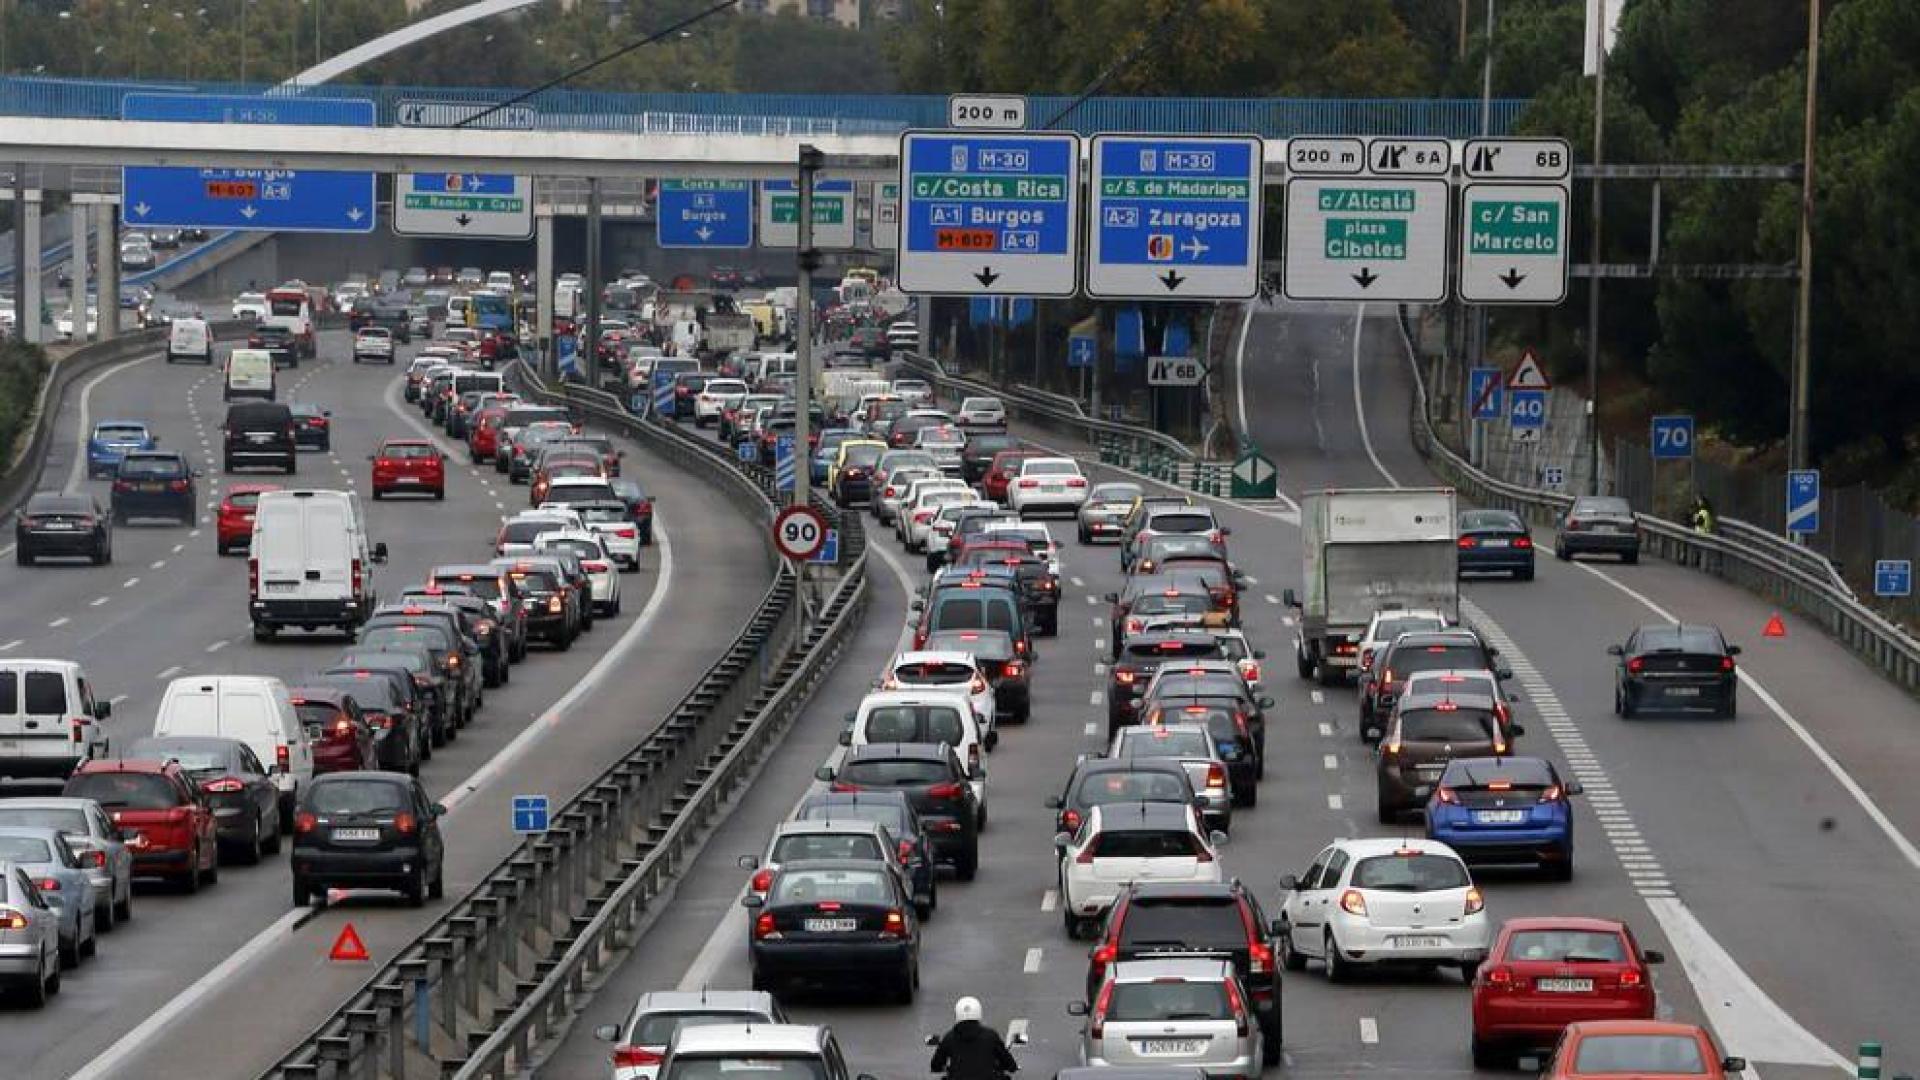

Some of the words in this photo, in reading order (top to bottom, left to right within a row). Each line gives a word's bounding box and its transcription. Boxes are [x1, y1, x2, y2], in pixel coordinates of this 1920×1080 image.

[958, 107, 992, 120] 200
[1004, 109, 1018, 120] m
[981, 153, 1026, 167] M-30
[1167, 155, 1211, 168] M-30
[1297, 150, 1329, 162] 200
[1342, 152, 1354, 162] m
[1536, 153, 1560, 167] 6B
[917, 179, 1003, 198] c/Costa
[1017, 180, 1060, 198] Rica
[1144, 182, 1162, 194] de
[1321, 191, 1411, 211] c/Alcalá
[934, 209, 960, 222] A-1
[971, 208, 1044, 227] Burgos
[1109, 211, 1136, 224] A-2
[1149, 209, 1241, 229] Zaragoza
[1482, 203, 1503, 223] c/
[1512, 206, 1548, 223] San
[1346, 223, 1386, 236] plaza
[938, 232, 994, 248] M-607
[1005, 235, 1036, 248] A-6
[1474, 233, 1554, 249] Marcelo
[1328, 240, 1403, 257] Cibeles
[1513, 400, 1543, 417] 40
[1658, 428, 1688, 447] 70
[785, 523, 816, 541] 90
